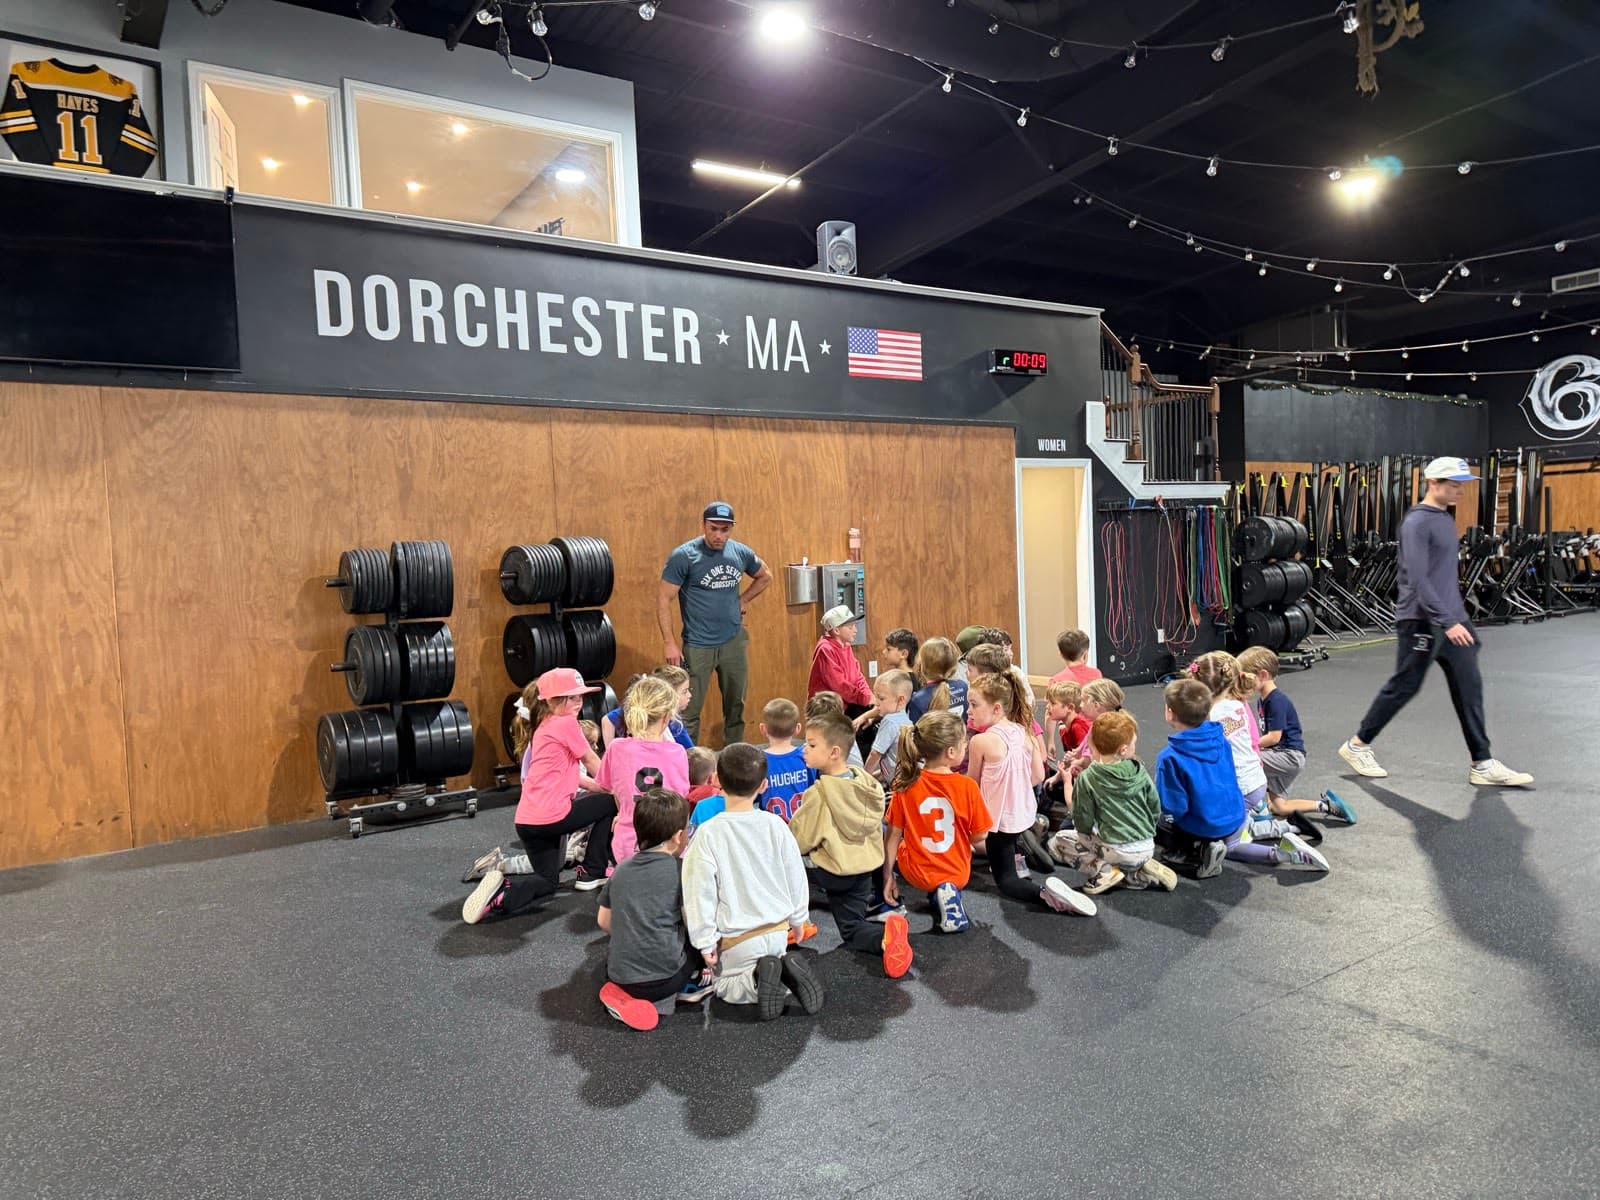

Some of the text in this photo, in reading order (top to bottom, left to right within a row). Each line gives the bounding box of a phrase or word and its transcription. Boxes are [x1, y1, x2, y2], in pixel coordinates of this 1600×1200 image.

[56, 93, 100, 114] HAYES
[57, 111, 103, 165] 11
[313, 269, 810, 373] DORCHESTER MA
[1013, 352, 1046, 369] 00:09
[1037, 438, 1066, 452] WOMEN
[700, 573, 713, 587] SIX
[710, 564, 724, 577] ONE
[711, 579, 736, 589] CROSSFIT
[769, 768, 808, 788] HUGHES
[919, 796, 956, 854] 3
